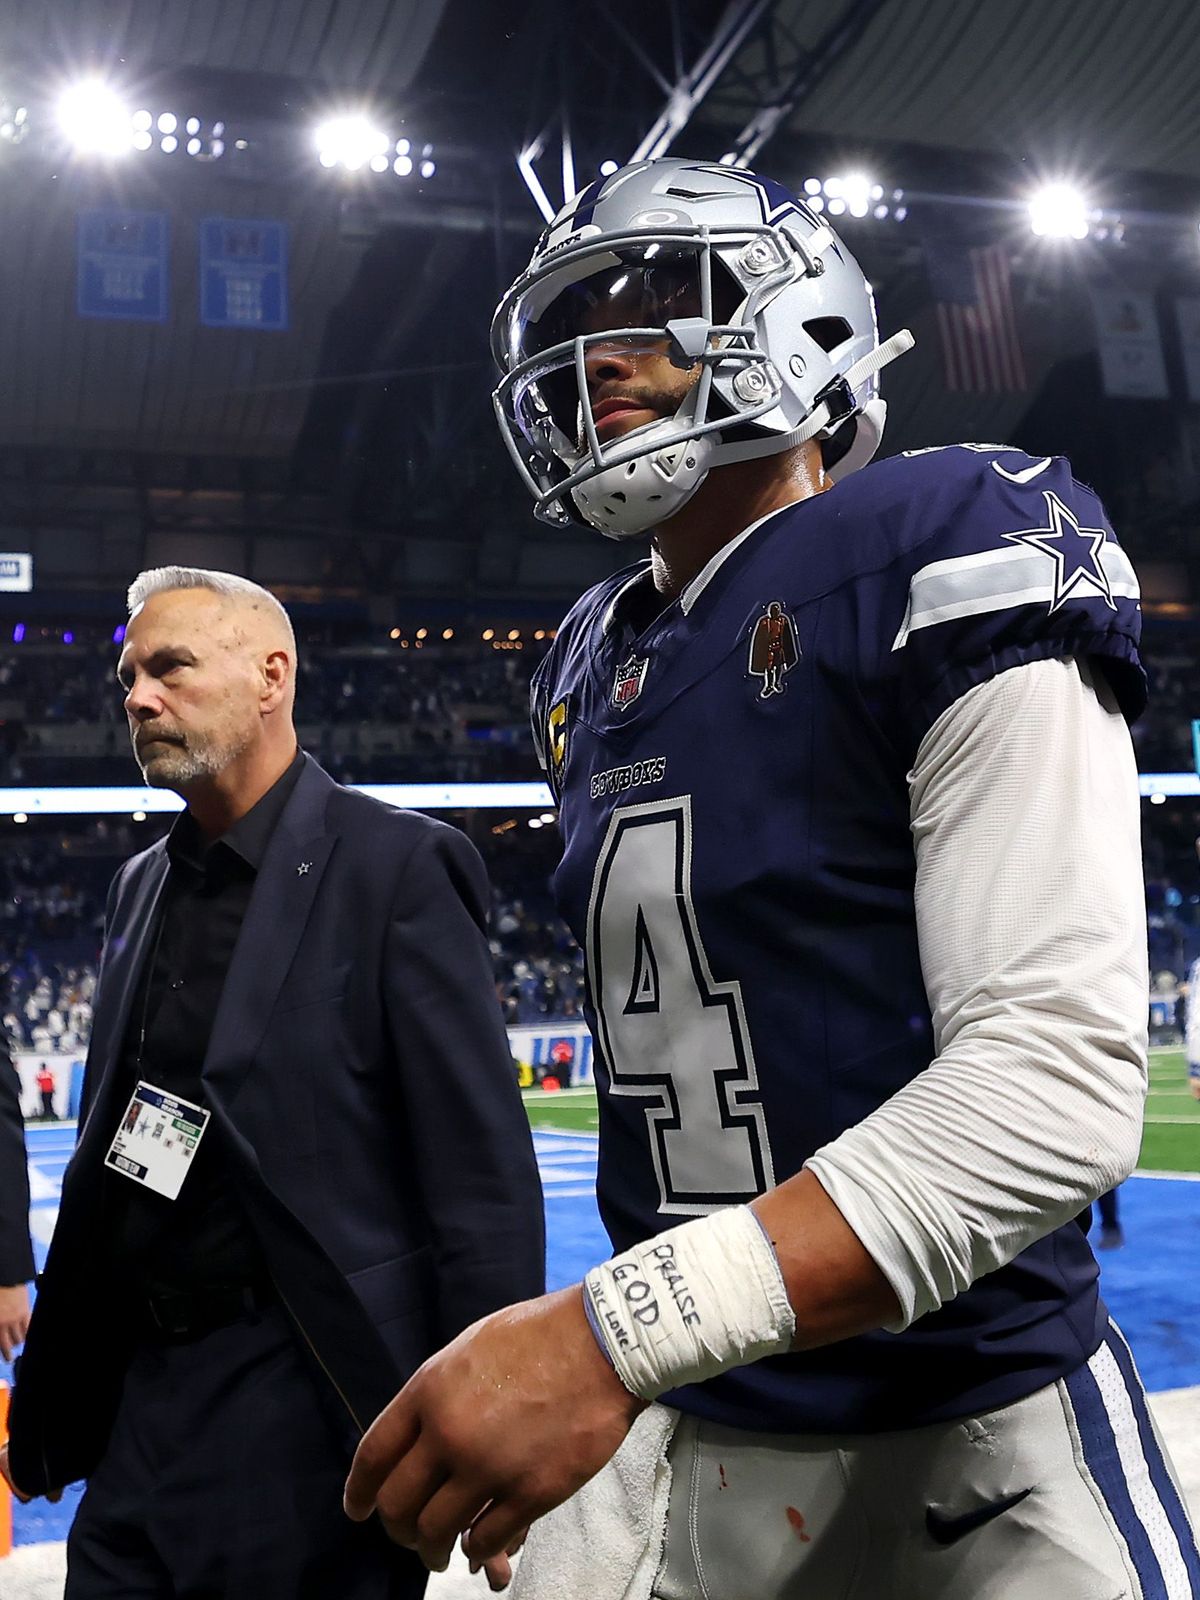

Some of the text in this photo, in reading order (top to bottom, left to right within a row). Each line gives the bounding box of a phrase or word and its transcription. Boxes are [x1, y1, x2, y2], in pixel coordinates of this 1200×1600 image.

[616, 678, 639, 702] NFL
[590, 756, 667, 799] COWBOYS
[585, 795, 777, 1216] 4
[612, 1263, 660, 1326] GOD
[642, 1244, 701, 1327] PRAISE
